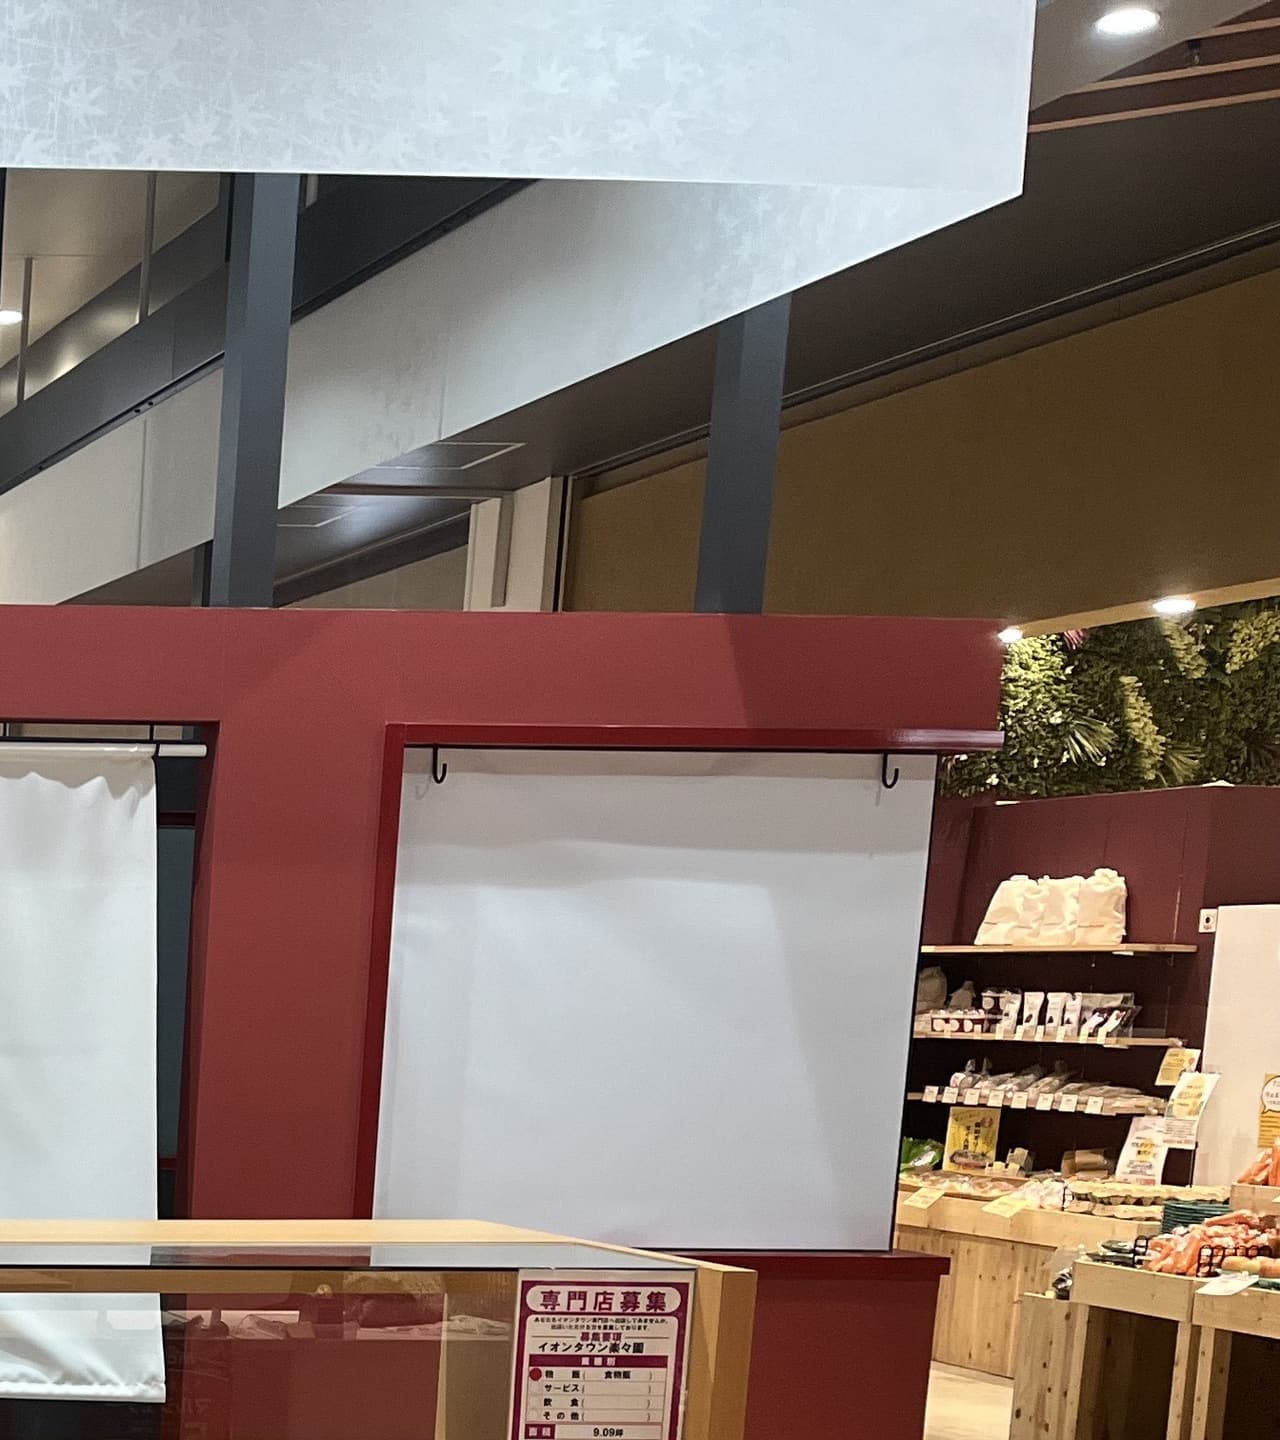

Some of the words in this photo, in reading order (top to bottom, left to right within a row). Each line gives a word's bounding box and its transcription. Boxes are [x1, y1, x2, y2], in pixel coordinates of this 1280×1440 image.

[540, 1290, 666, 1312] 専門店募集
[538, 1342, 644, 1354] イオンタウン楽々園
[593, 1427, 624, 1438] 9.09坪
